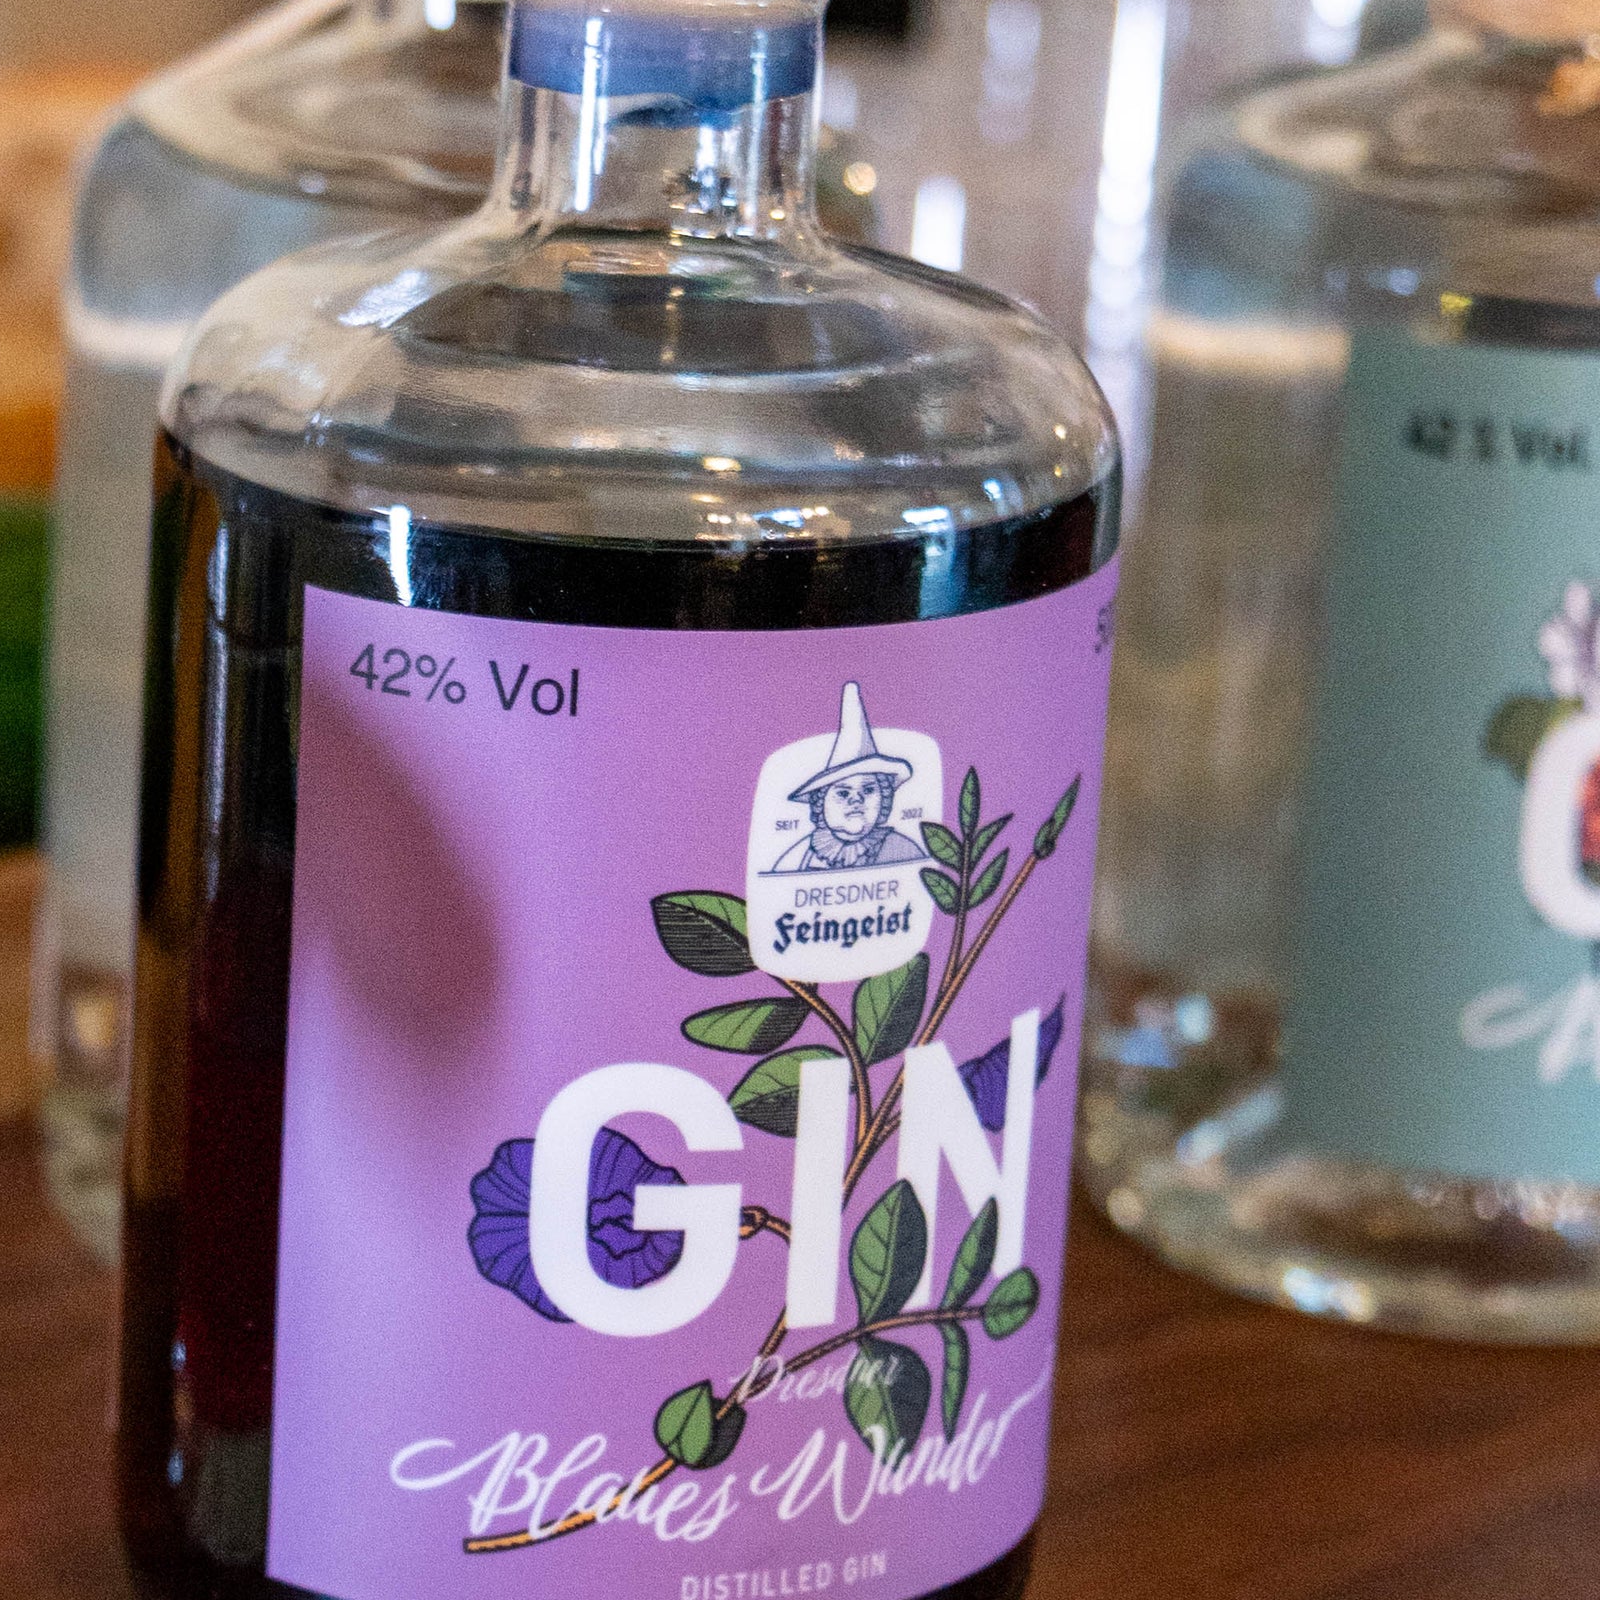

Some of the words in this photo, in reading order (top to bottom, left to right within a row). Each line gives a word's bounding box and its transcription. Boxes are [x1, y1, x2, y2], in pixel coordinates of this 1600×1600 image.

[349, 643, 467, 705] 42%
[488, 659, 579, 718] Vol
[774, 818, 800, 832] SEIT
[794, 879, 900, 908] DRESDNER
[773, 902, 913, 955] Feingeist
[528, 1008, 1041, 1337] GIN
[727, 1353, 901, 1403] Dresdner
[389, 1431, 740, 1542] Blaues
[750, 1365, 1052, 1525] Wunder
[842, 1551, 889, 1581] GIN
